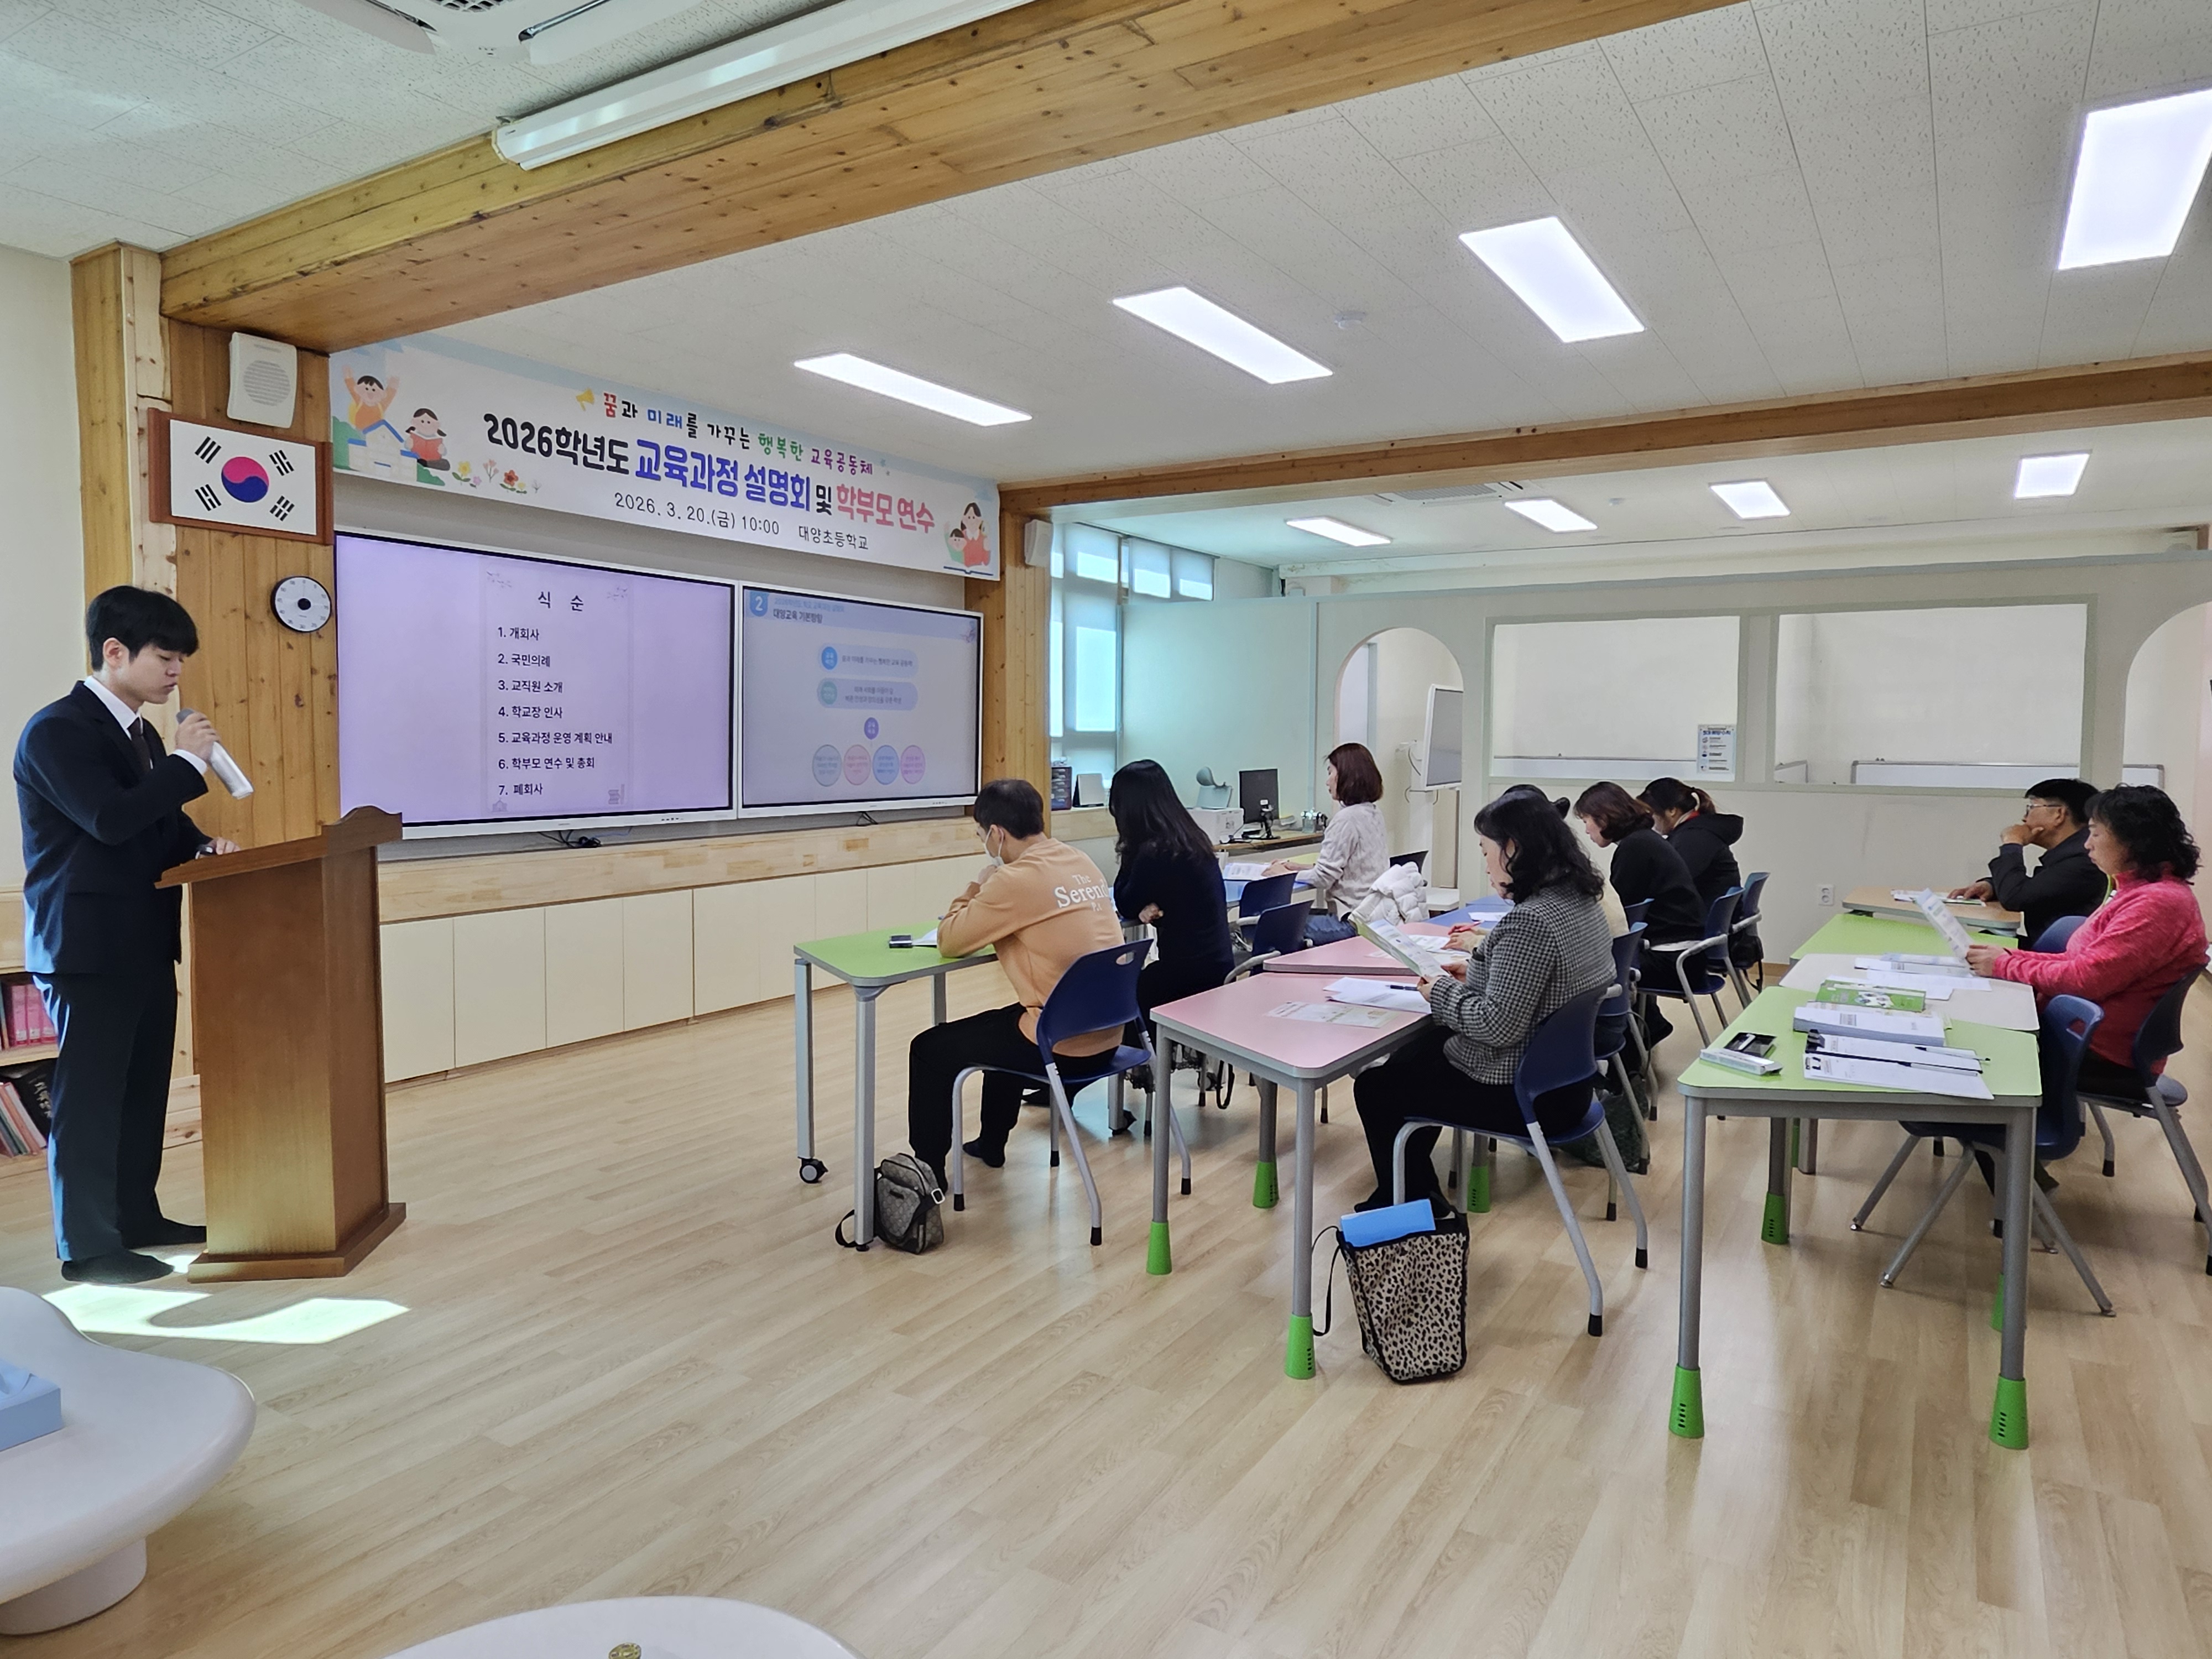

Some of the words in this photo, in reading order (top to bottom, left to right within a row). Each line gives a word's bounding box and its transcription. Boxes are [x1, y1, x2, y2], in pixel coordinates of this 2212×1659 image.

[604, 392, 638, 418] 꿈과
[648, 409, 698, 439] 미래를
[707, 424, 750, 450] 가꾸는
[758, 433, 804, 461] 행복한
[811, 448, 873, 475] 교육공동체
[484, 413, 629, 475] 2026학년도
[635, 439, 738, 497] 교육과정
[744, 464, 810, 512] 설명회
[816, 485, 832, 515] 및
[837, 484, 894, 527] 학부모
[897, 498, 935, 534] 연수
[742, 516, 779, 535] 10:00
[799, 525, 869, 550] 대양초등학교
[538, 591, 551, 609] 식
[570, 595, 584, 612] 순
[755, 596, 763, 611] 2
[498, 627, 507, 638] 1.
[509, 627, 540, 640] 개회사
[498, 654, 508, 665] 2.
[511, 654, 550, 667] 국민의례
[498, 680, 509, 691] 3.
[511, 680, 541, 692] 교직원
[544, 681, 563, 693] 소개
[498, 707, 509, 717] 4.
[512, 706, 541, 718] 학교장
[544, 707, 563, 718] 인사
[498, 733, 509, 743] 5.
[512, 732, 550, 744] 교육과정
[553, 732, 571, 744] 운영
[574, 733, 592, 744] 계획
[594, 733, 613, 744] 안내
[498, 759, 509, 769] 6.
[512, 758, 541, 770] 학부모
[544, 758, 563, 769] 연수
[566, 757, 575, 769] 및
[577, 757, 595, 769] 총회
[498, 785, 508, 795] 7.
[1072, 874, 1092, 885] The
